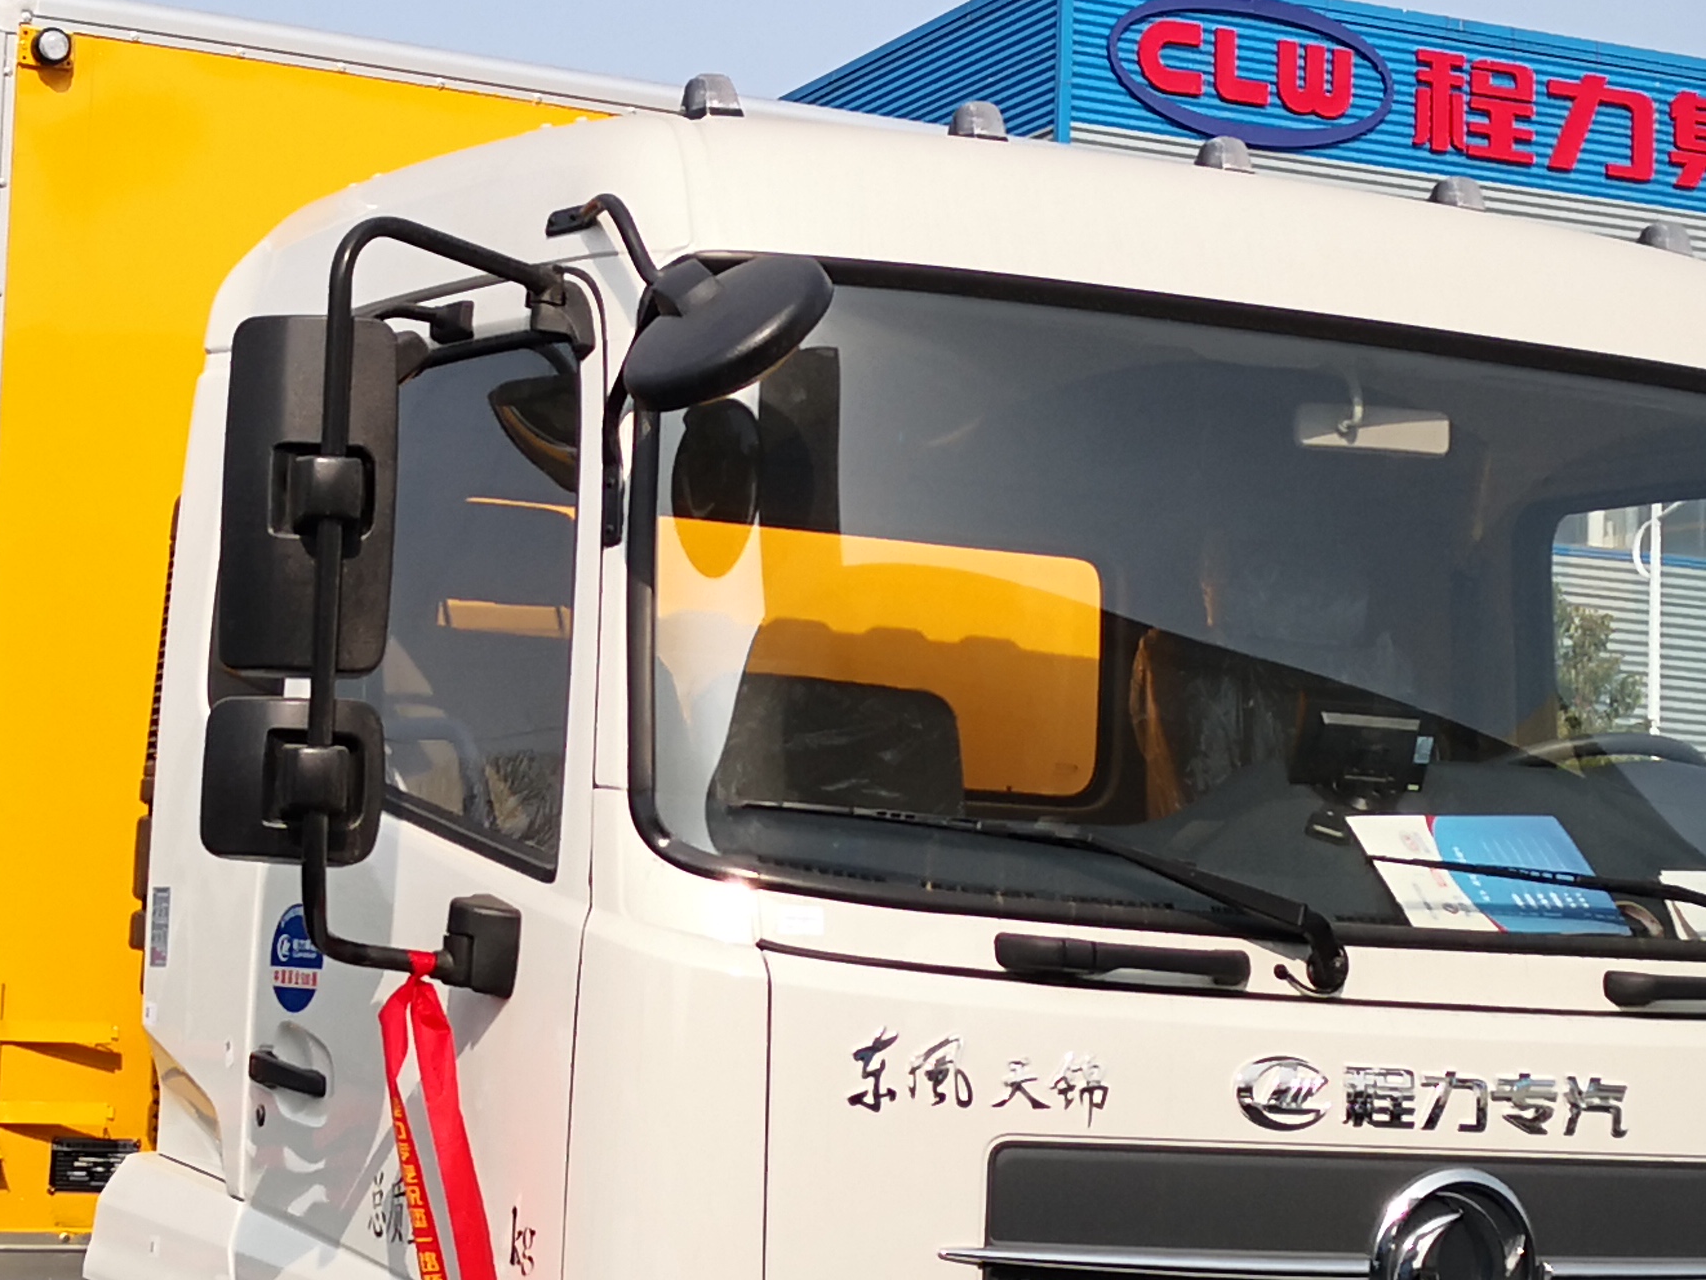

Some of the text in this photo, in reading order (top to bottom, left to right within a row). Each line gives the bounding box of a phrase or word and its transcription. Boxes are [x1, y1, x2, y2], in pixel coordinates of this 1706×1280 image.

[1137, 20, 1354, 119] CLW
[1342, 1066, 1630, 1139] 程力专汽
[367, 1171, 537, 1277] 总质 kg
